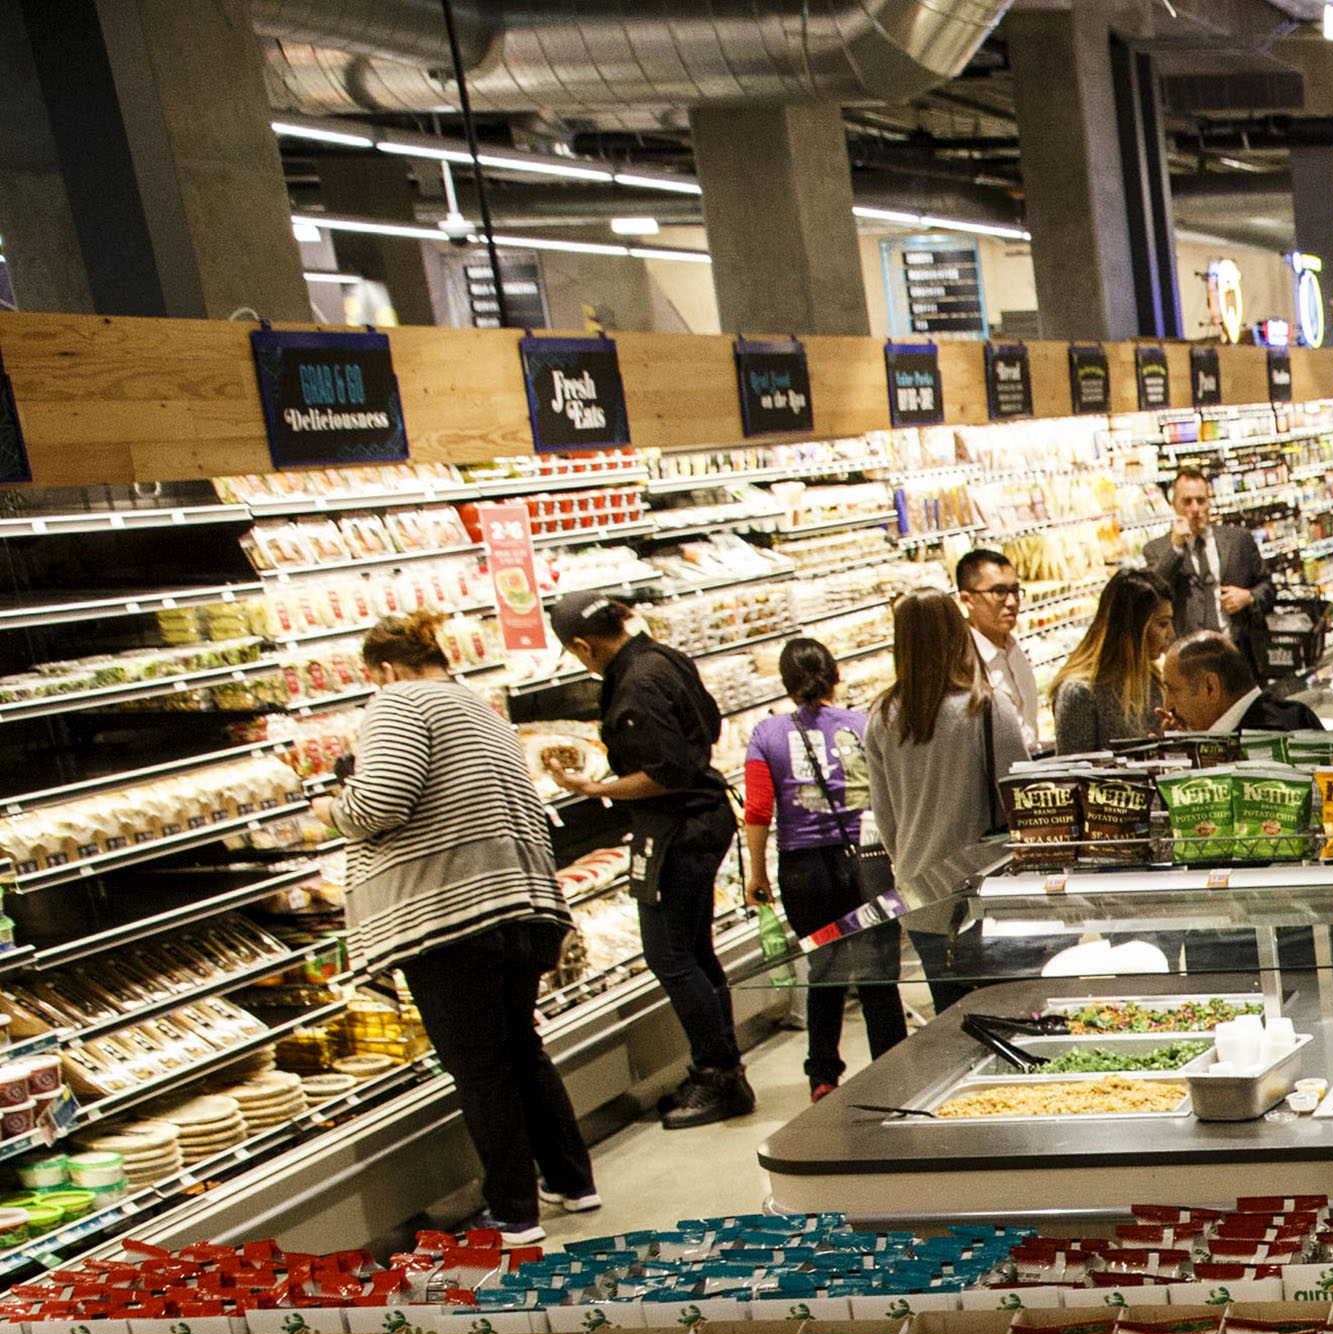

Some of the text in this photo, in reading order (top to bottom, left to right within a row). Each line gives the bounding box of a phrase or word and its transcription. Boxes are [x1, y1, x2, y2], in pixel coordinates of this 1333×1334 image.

[550, 369, 598, 413] Fresh
[284, 408, 390, 432] Deliciousness
[566, 400, 607, 430] Eats
[1012, 784, 1074, 811] KETTLE
[1088, 782, 1148, 811] KETTLE
[1171, 783, 1231, 808] KETTLE
[1244, 783, 1302, 805] KETTLE
[1017, 816, 1049, 826] POTATO
